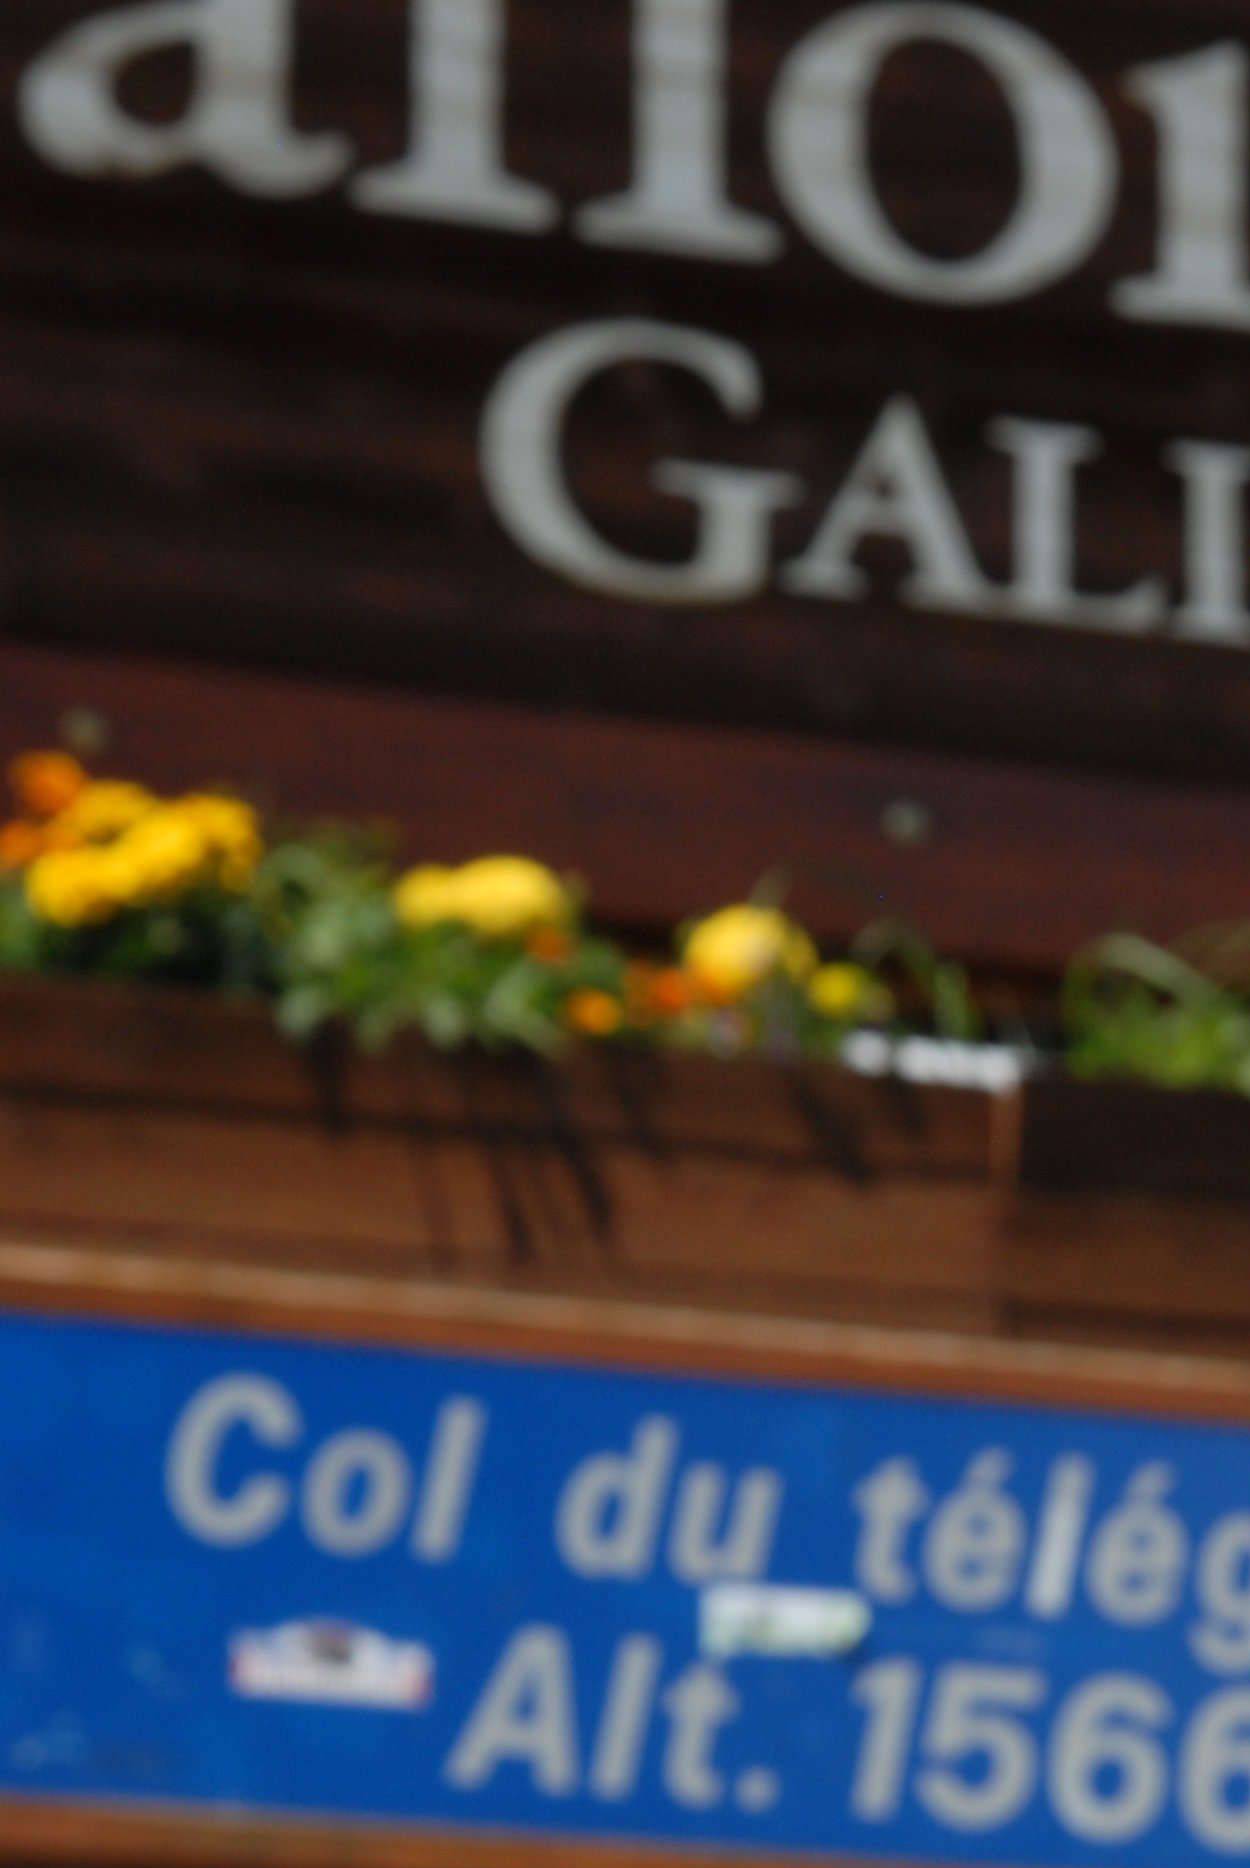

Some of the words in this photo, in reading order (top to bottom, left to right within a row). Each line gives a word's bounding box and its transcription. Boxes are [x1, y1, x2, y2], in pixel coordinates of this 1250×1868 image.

[164, 1370, 486, 1564] Col
[554, 1413, 782, 1584] du
[442, 1622, 781, 1813] Alt.
